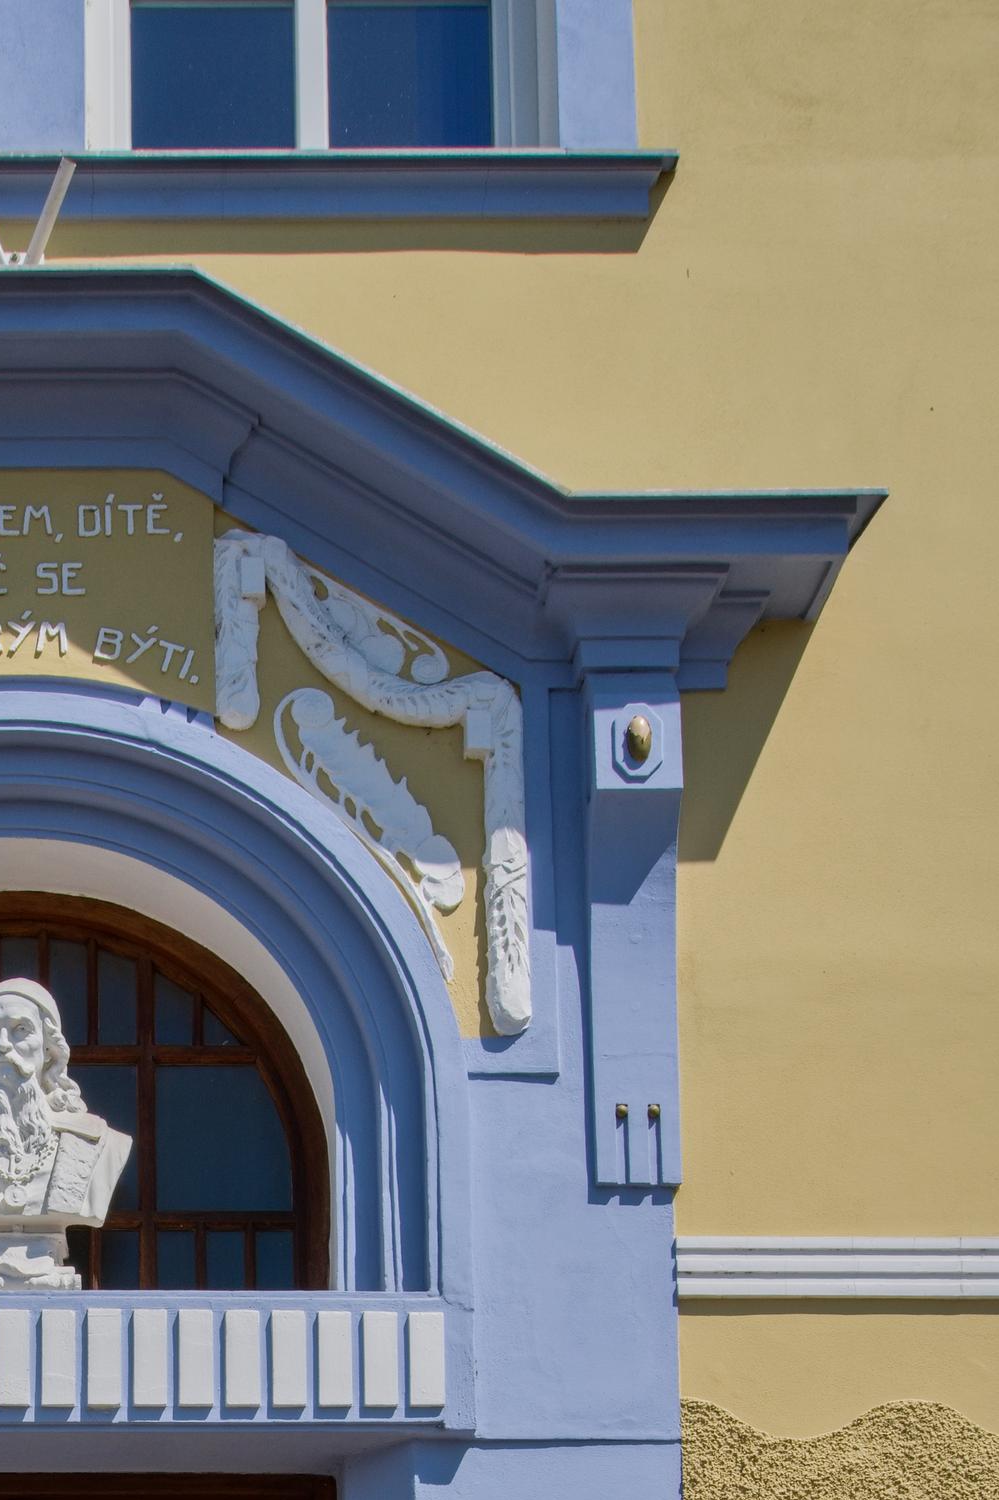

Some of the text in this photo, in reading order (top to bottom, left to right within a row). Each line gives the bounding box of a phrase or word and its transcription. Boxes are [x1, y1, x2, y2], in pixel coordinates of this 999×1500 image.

[78, 493, 184, 543] DÍTĚ,
[36, 562, 86, 595] SE
[94, 625, 200, 684] BÝTI.
